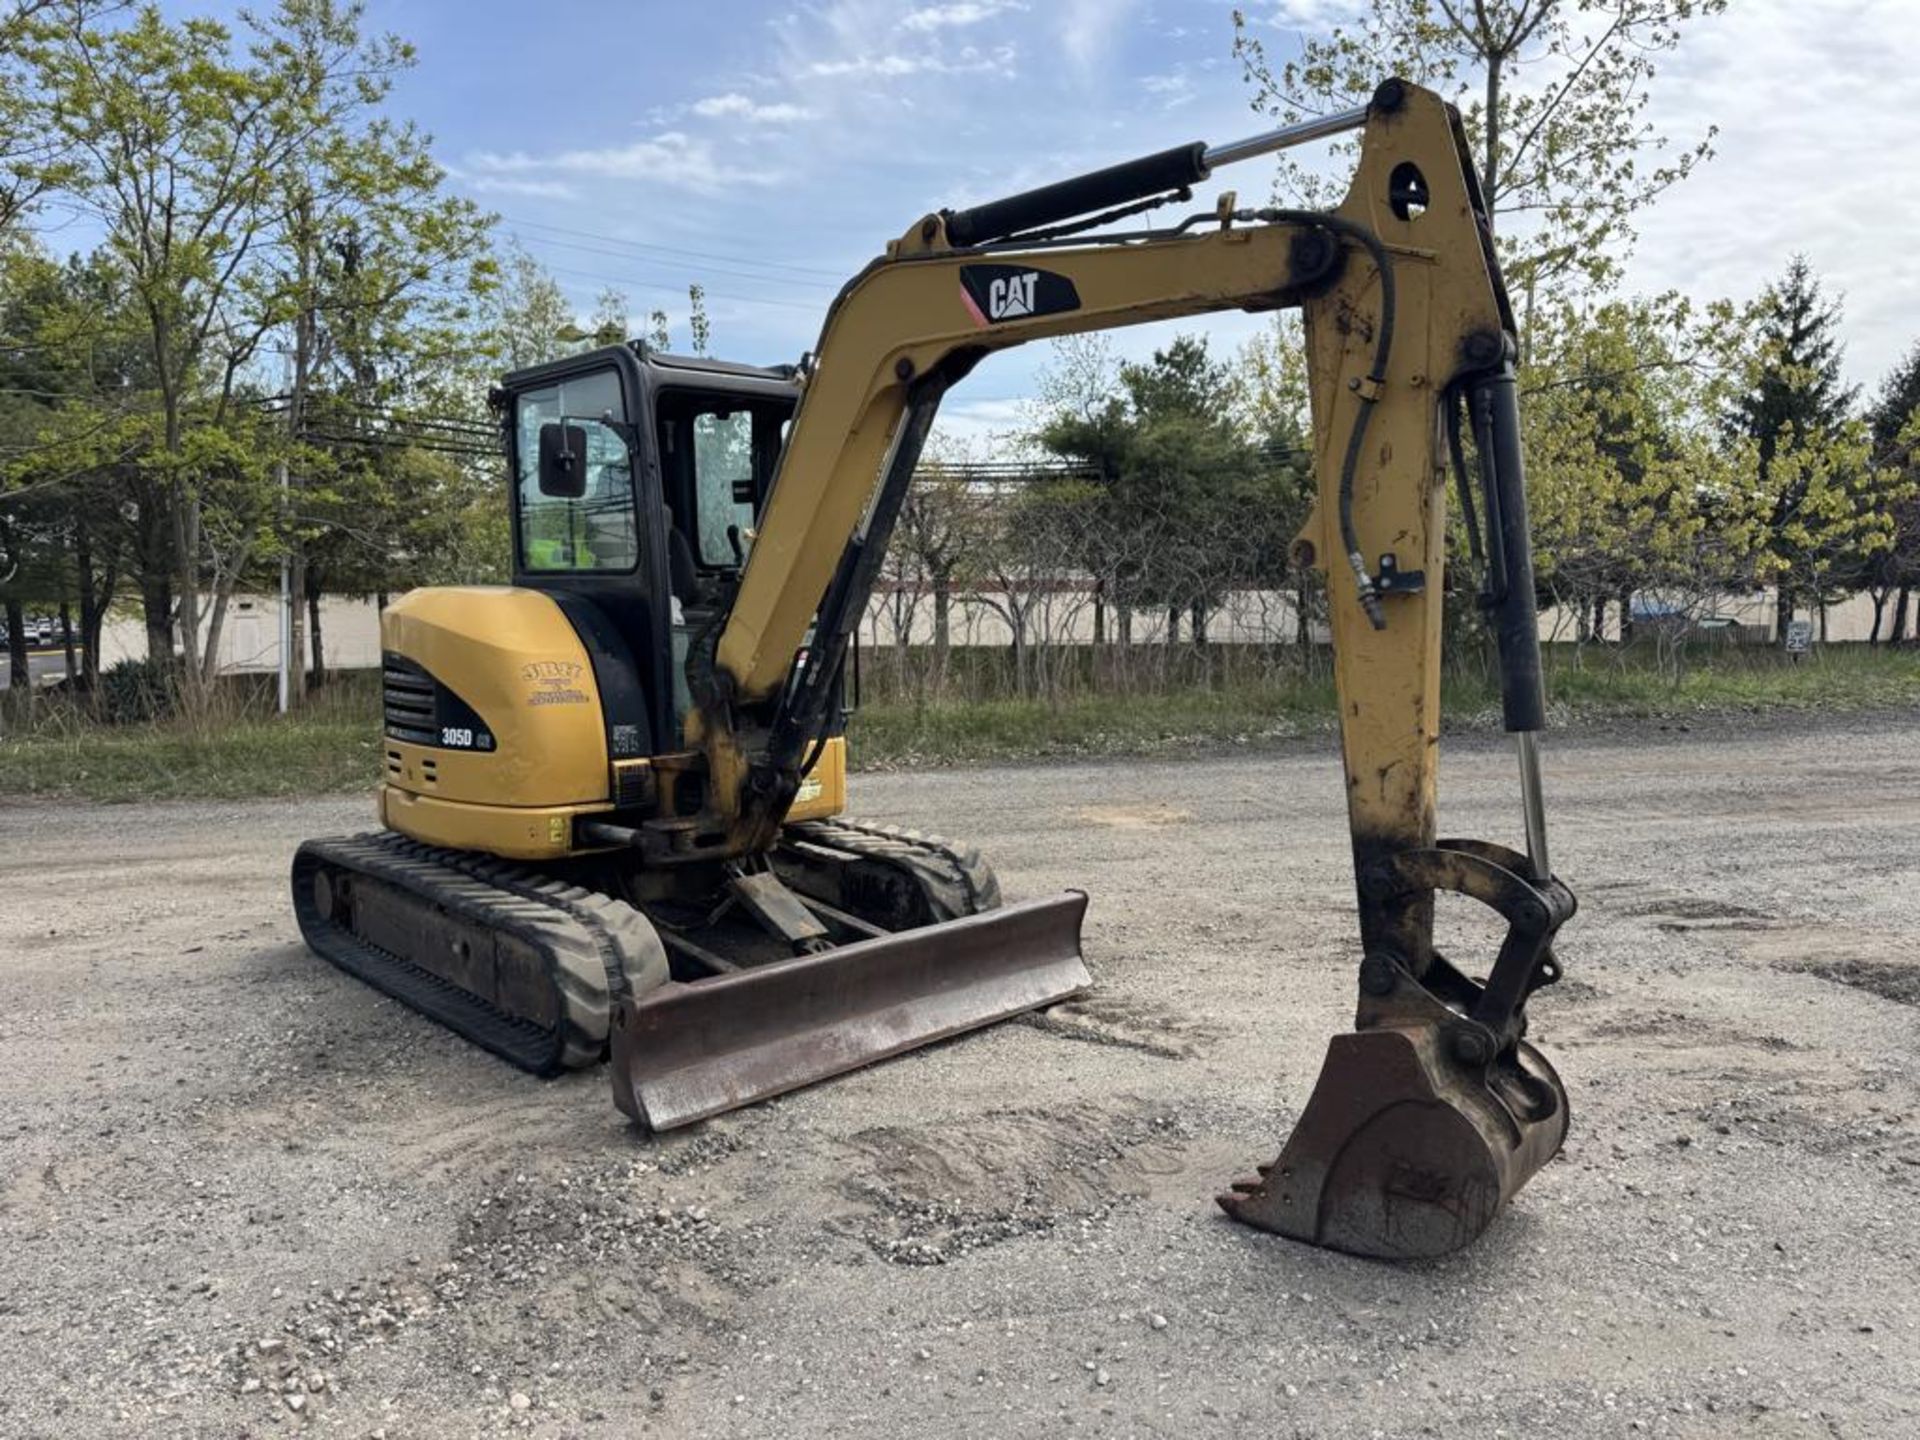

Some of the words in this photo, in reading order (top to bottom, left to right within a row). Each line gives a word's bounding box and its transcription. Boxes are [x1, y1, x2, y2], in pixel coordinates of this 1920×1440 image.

[989, 272, 1038, 319] CAT
[1788, 638, 1809, 650] 25
[442, 727, 472, 746] 305D
